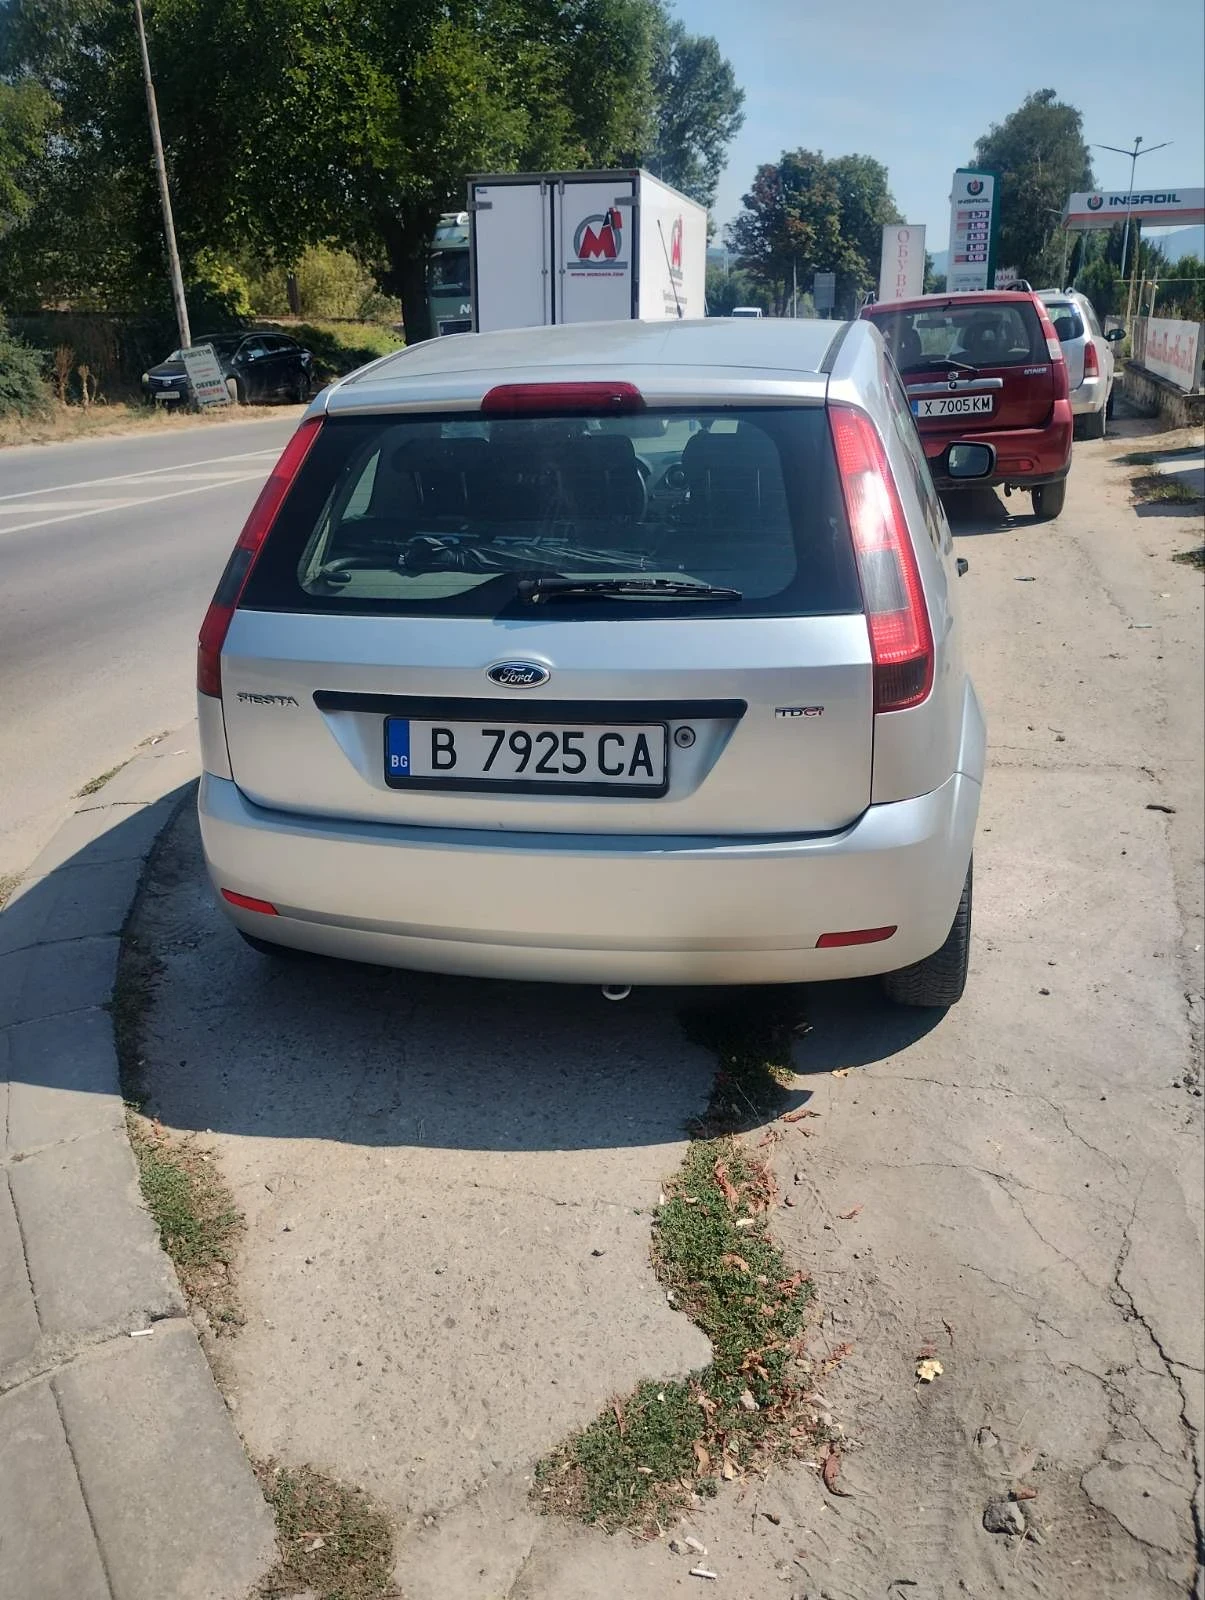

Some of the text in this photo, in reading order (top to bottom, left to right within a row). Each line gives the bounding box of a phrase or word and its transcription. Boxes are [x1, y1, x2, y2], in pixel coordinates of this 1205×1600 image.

[1109, 194, 1181, 205] INSAOIL
[925, 397, 990, 415] X 7005 KM
[500, 667, 534, 683] Ford
[237, 693, 299, 706] FIESTA
[431, 728, 654, 777] B 7925 CA
[391, 755, 408, 768] BG
